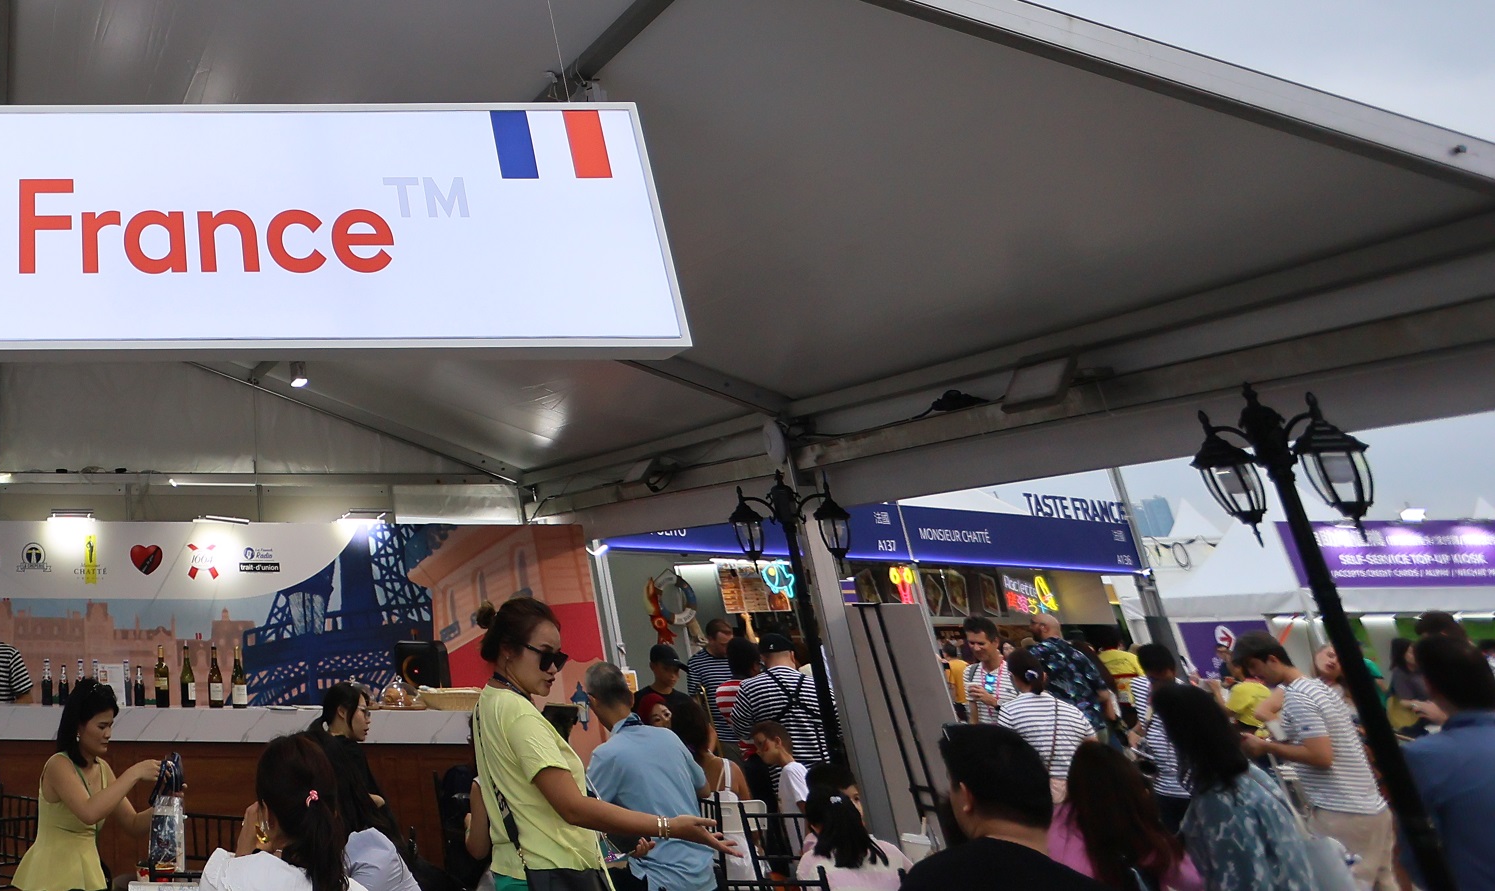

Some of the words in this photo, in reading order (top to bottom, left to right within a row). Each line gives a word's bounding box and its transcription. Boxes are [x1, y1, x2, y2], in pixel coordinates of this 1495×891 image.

[18, 178, 394, 275] France
[1022, 493, 1071, 518] TASTE
[1069, 497, 1128, 524] FRANCE
[873, 511, 891, 525] 法國
[918, 527, 962, 542] MONSIEUR
[961, 529, 992, 544] CHATTÉ
[878, 540, 896, 551] A137
[240, 563, 279, 571] trait-d'union
